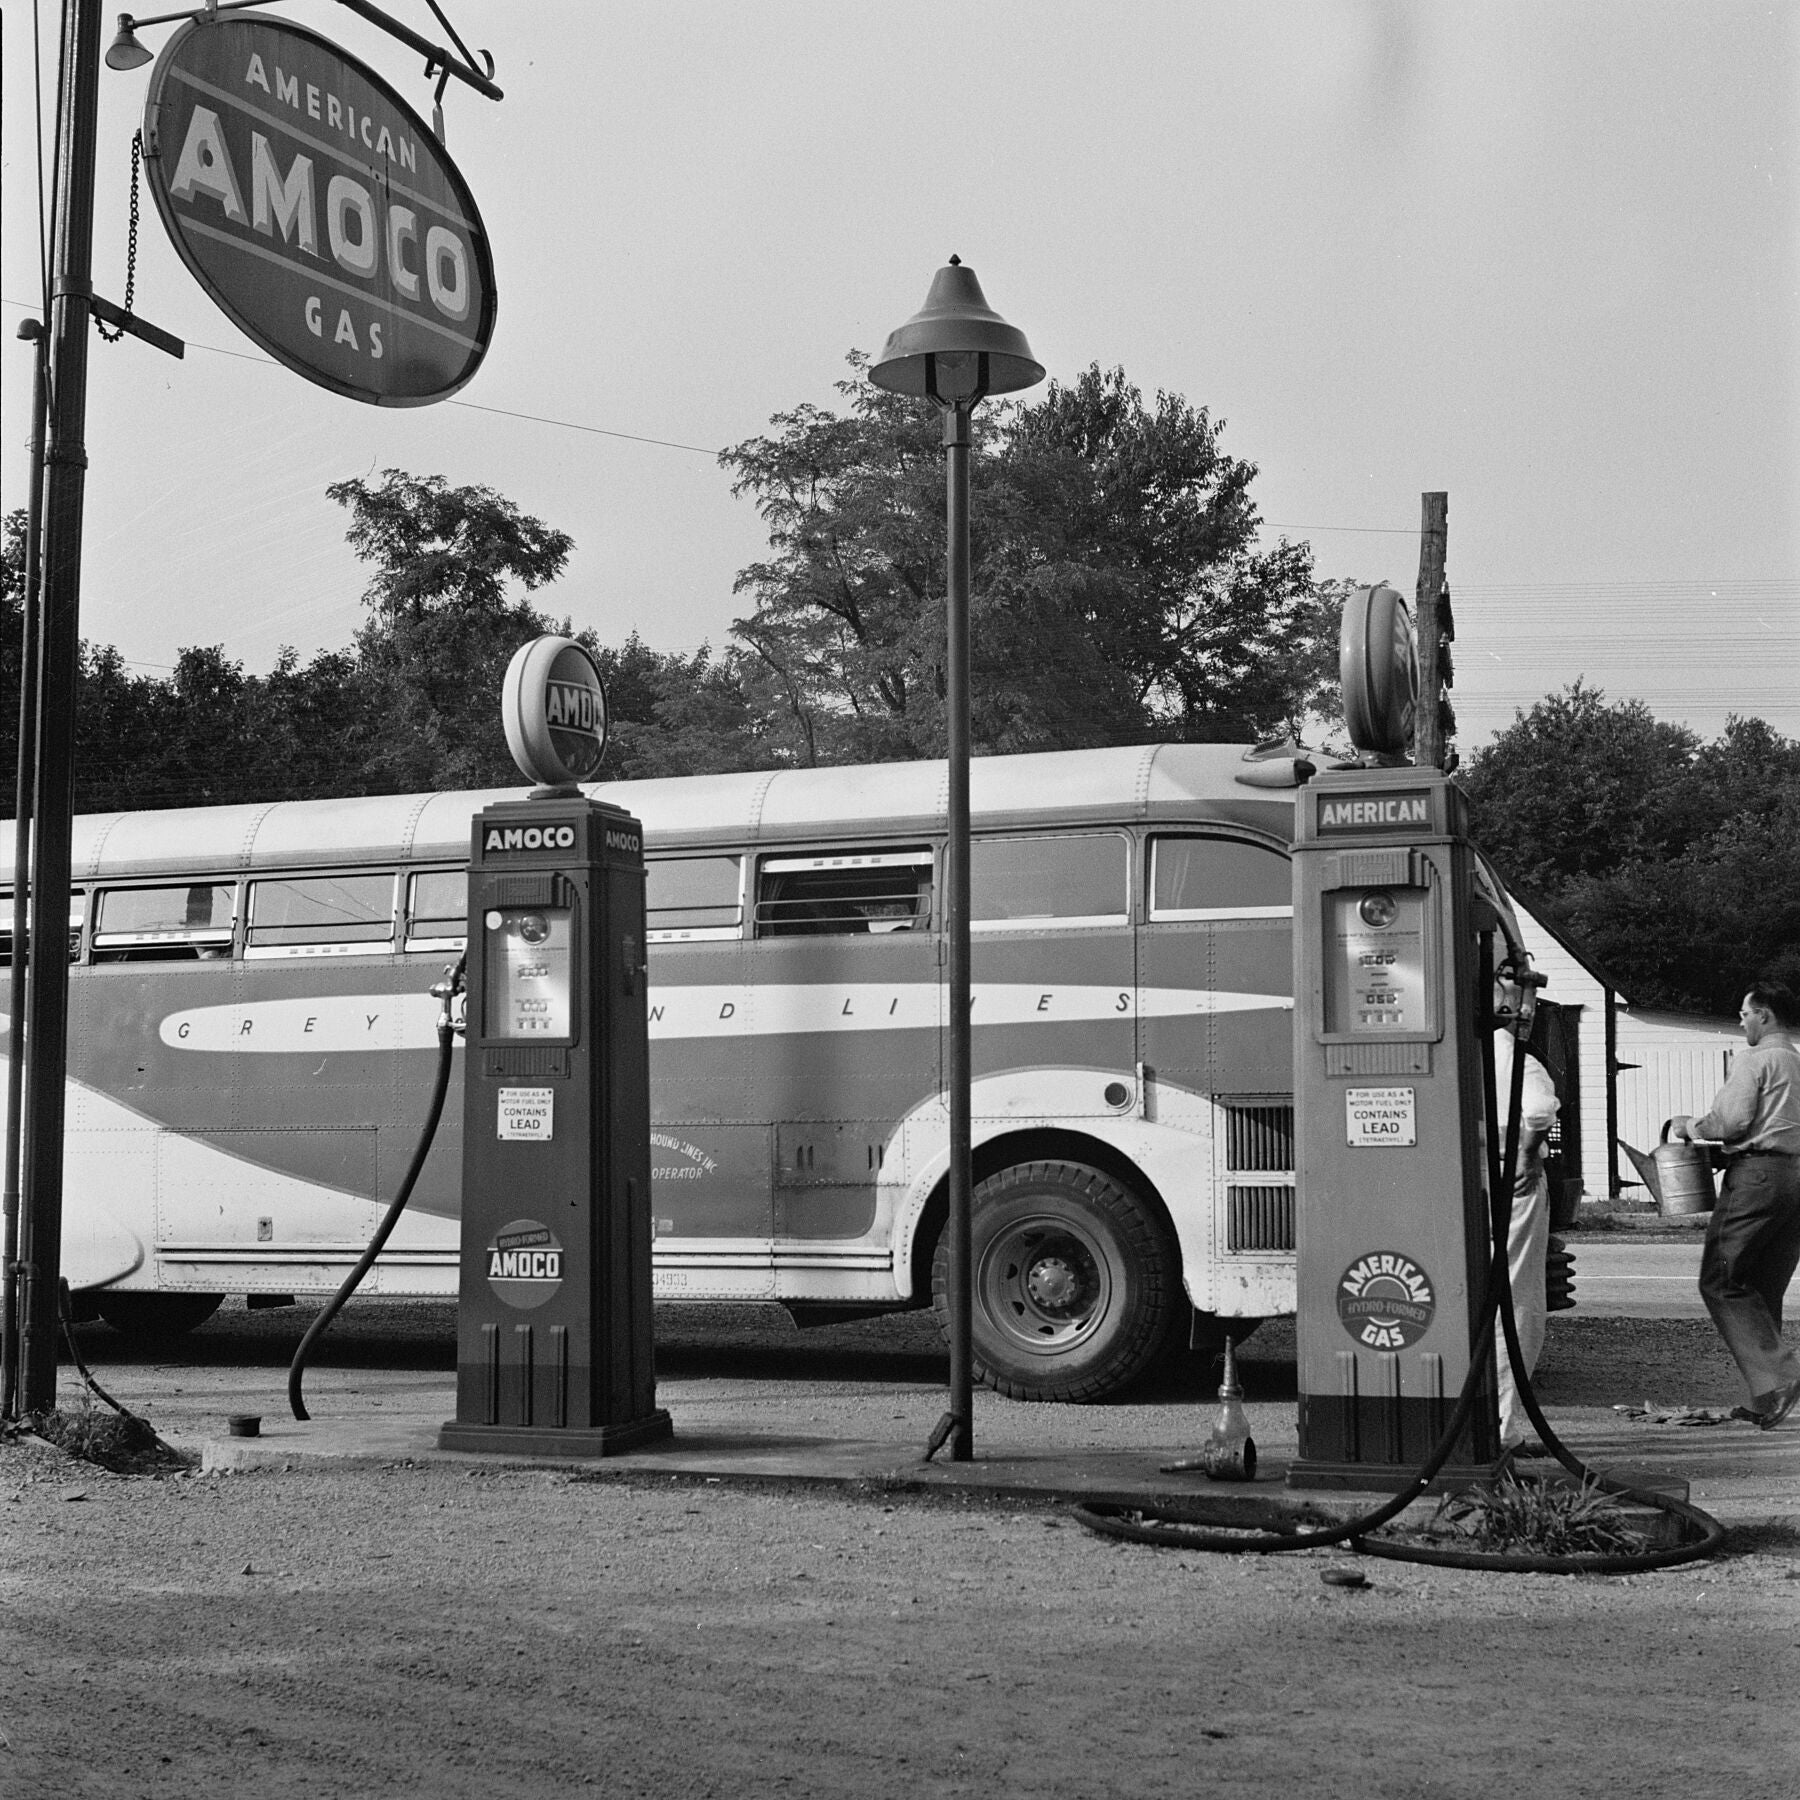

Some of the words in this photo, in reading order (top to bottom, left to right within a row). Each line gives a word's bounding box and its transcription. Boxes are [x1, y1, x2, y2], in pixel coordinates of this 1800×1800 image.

[245, 52, 417, 174] AMERICAN
[169, 104, 470, 323] AMOCO
[304, 296, 385, 359] GAS
[1322, 799, 1427, 825] AMERICAN
[485, 826, 574, 850] AMOCO
[606, 830, 639, 852] AMOCO
[842, 993, 1131, 1016] LIES
[504, 1108, 547, 1116] CONTAINS
[1354, 1110, 1407, 1119] CONTAINS
[510, 1119, 541, 1129] LEAD
[1362, 1123, 1400, 1134] LEAD
[650, 1133, 680, 1150] HOUND
[680, 1141, 704, 1162] LINES
[651, 1167, 703, 1179] OPERATOR
[489, 1252, 559, 1277] AMOCO
[1342, 1254, 1431, 1302] AMERICAN
[1361, 1324, 1405, 1347] GAS
